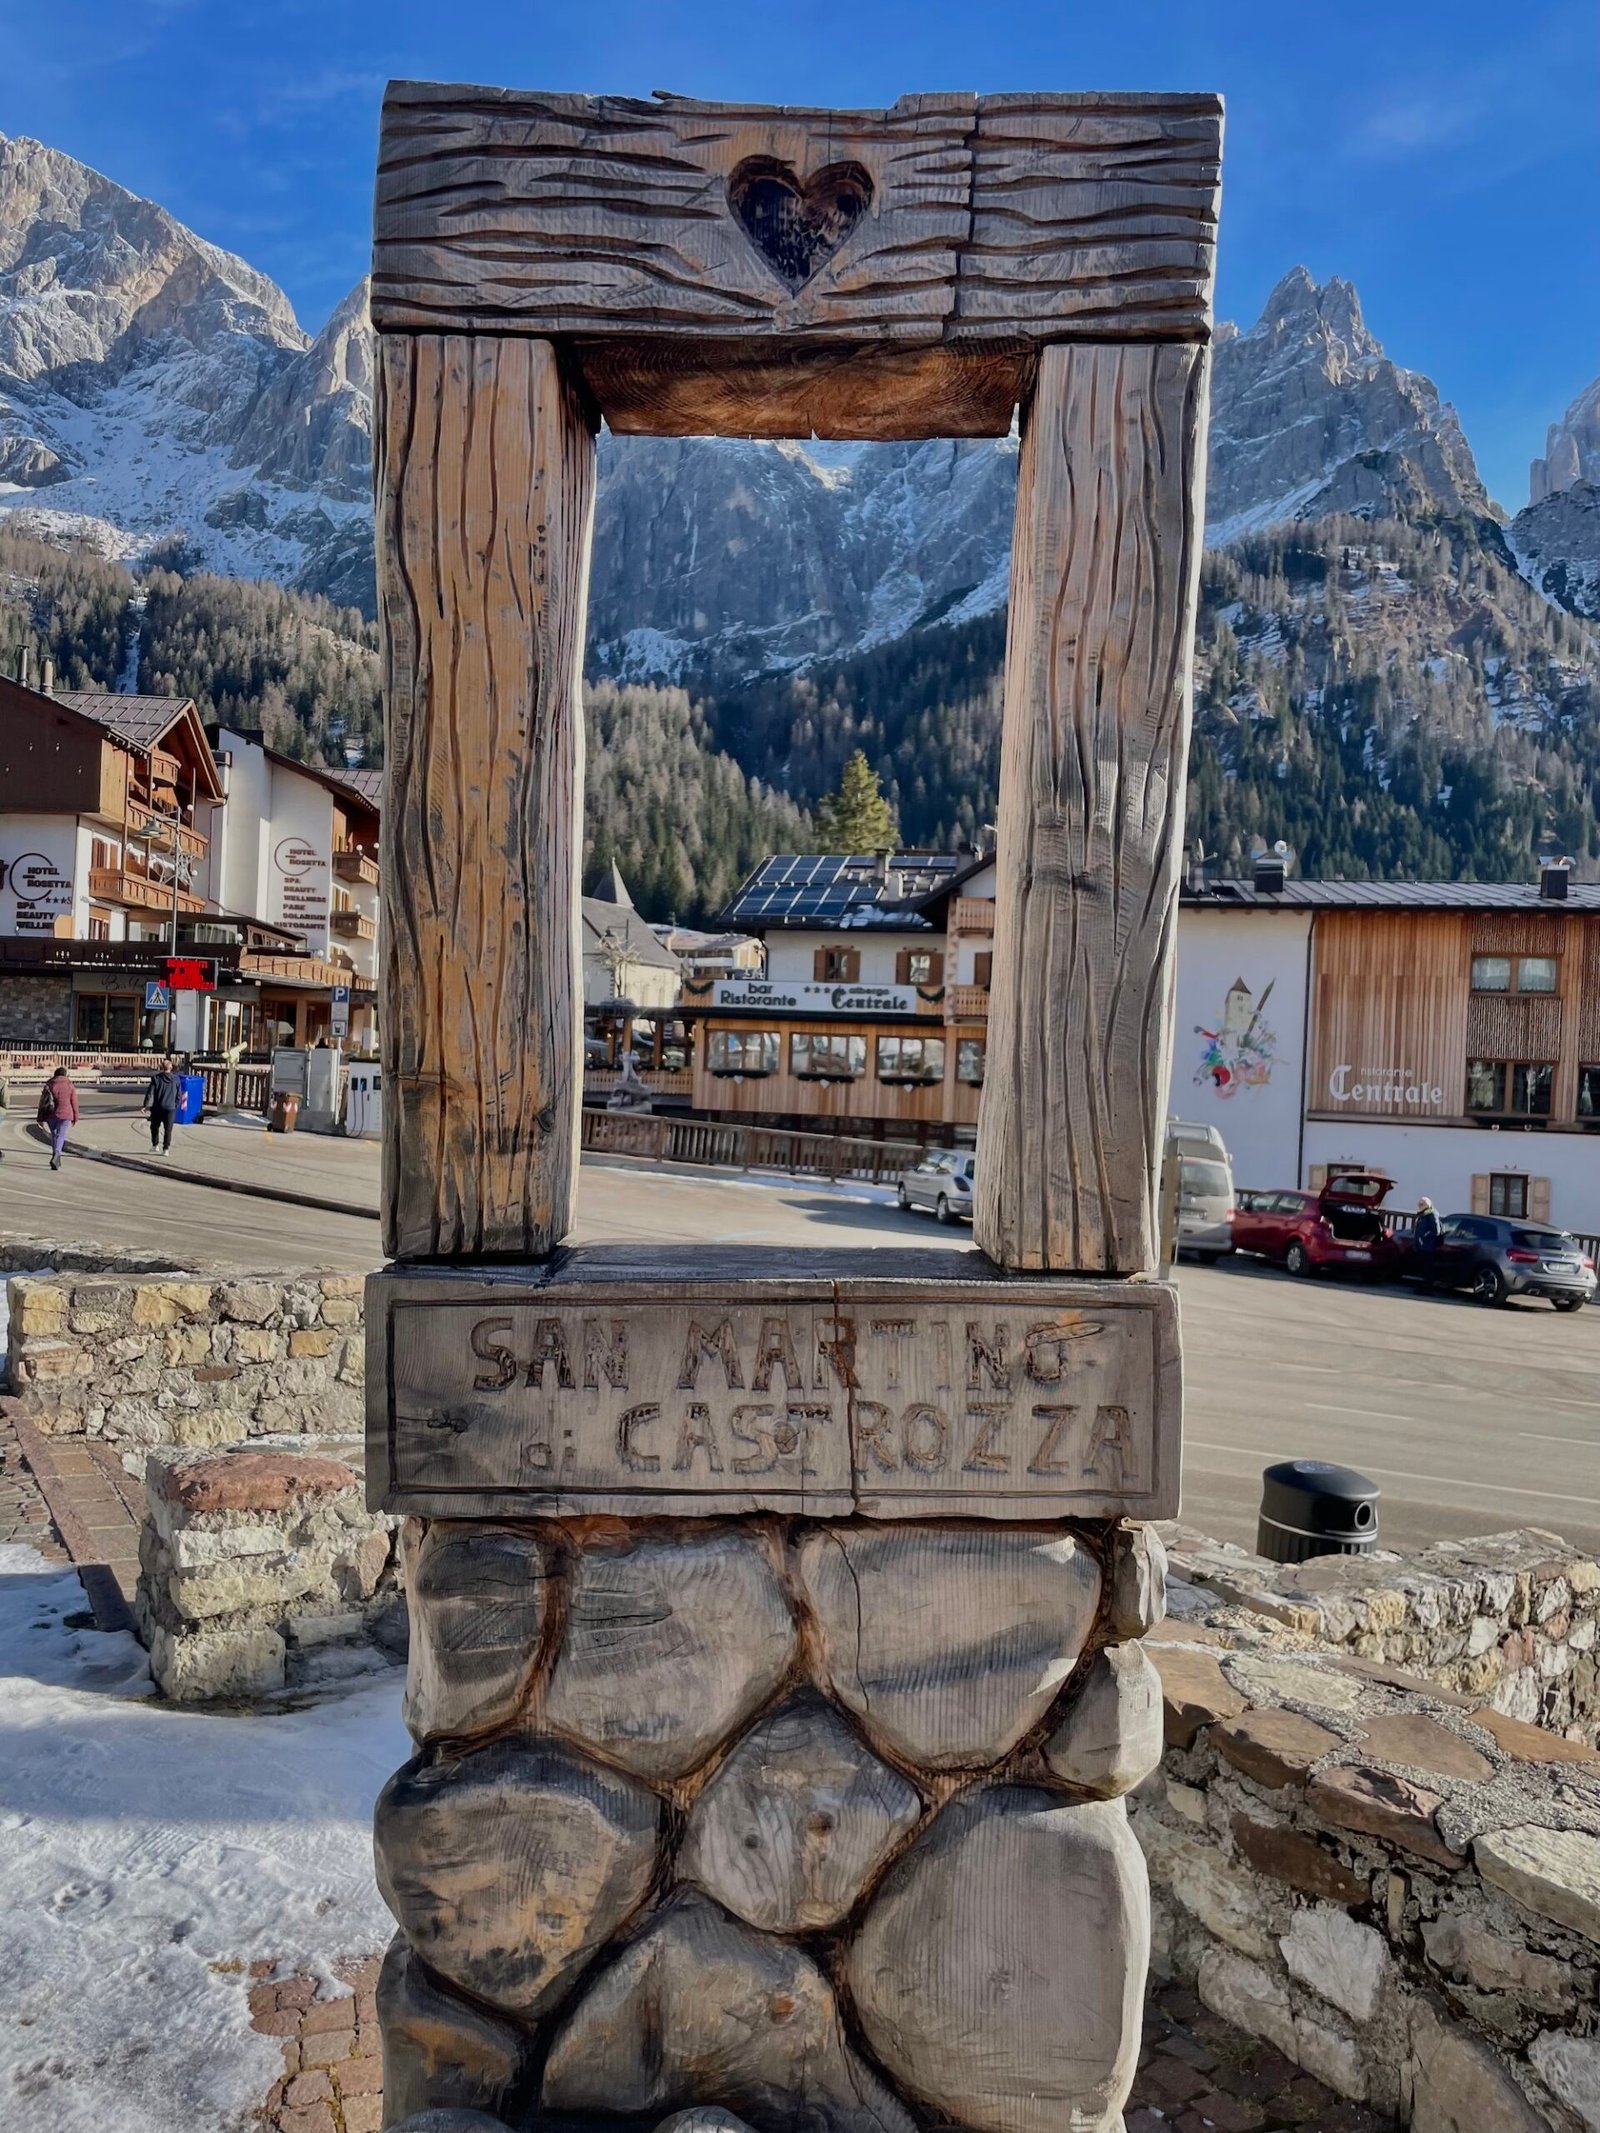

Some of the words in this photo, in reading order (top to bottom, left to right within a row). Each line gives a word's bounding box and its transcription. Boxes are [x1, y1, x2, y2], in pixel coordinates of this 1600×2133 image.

[289, 848, 317, 856] HOTEL
[289, 859, 326, 867] ROSETTA
[27, 867, 60, 875] HOTEL
[27, 880, 72, 888] ROSETTA
[17, 901, 36, 910] SPA
[16, 911, 55, 920] BEAUTY
[335, 987, 346, 1001] P
[748, 983, 773, 995] bar
[848, 986, 890, 997] albergo
[720, 990, 797, 1007] Ristorante
[831, 985, 908, 1010] Centrale
[1360, 1067, 1414, 1078] ristorante
[1329, 1064, 1443, 1105] Centrale
[470, 1317, 629, 1391] SAN
[676, 1317, 1075, 1391] MARTINO
[615, 1400, 1140, 1481] CASTROZZA
